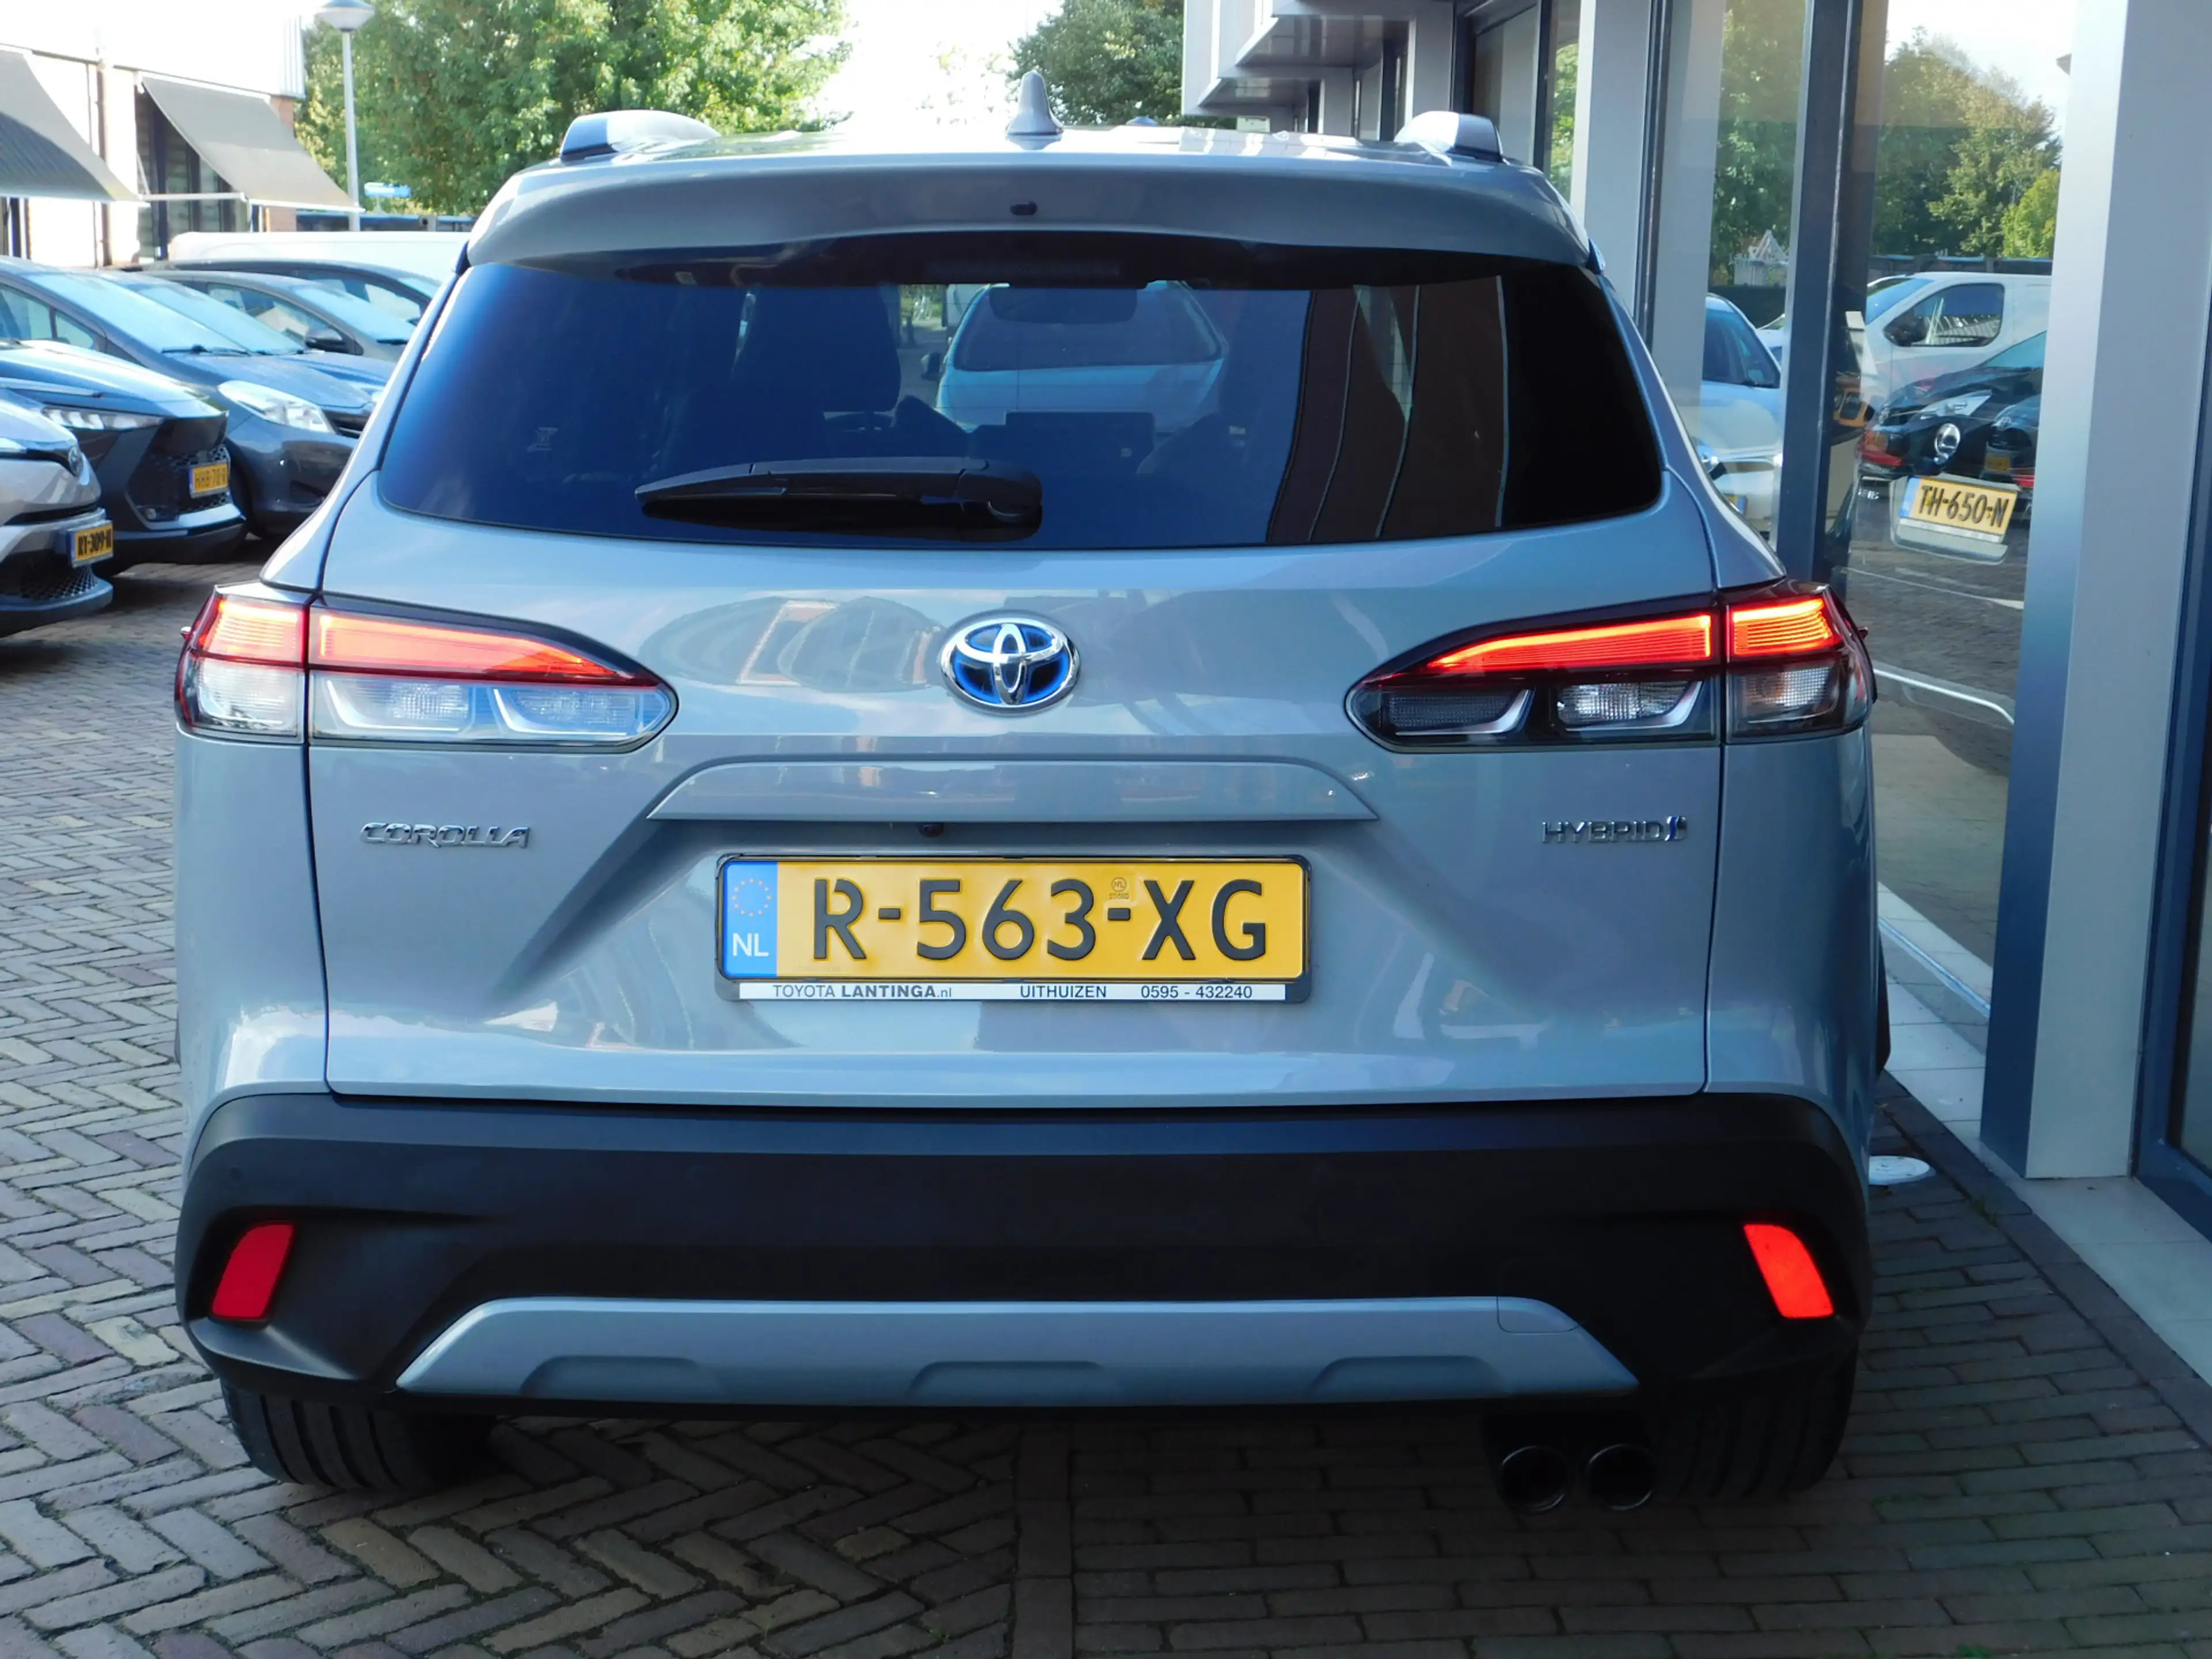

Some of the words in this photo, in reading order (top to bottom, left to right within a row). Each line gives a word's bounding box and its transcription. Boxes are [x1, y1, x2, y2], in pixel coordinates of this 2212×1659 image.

[1919, 486, 2009, 528] TH-650-N
[361, 822, 529, 848] COROLLA
[1542, 821, 1663, 843] HYBRID
[732, 933, 769, 957] NL
[812, 878, 1267, 961] R-563-XG
[772, 985, 835, 997] TOYOTA
[841, 985, 952, 997] LANTINGA.nl
[1020, 986, 1107, 998] UITHUIZEN
[1141, 986, 1179, 998] 0595
[1195, 986, 1253, 998] 432240
